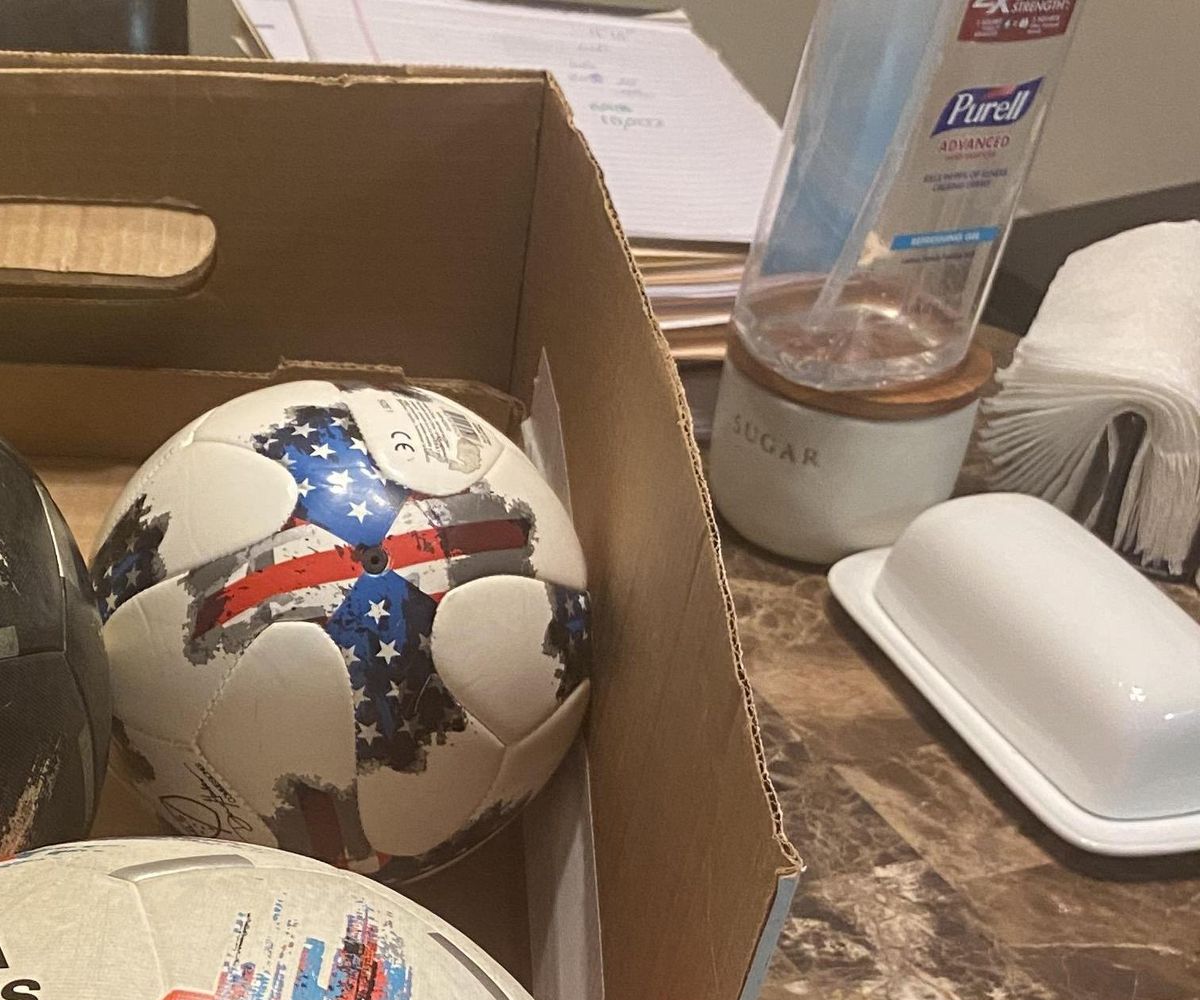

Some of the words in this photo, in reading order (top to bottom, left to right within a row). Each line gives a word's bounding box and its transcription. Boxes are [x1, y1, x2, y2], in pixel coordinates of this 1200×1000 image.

[947, 92, 1029, 125] Purell
[939, 135, 1010, 152] ADVANCED
[732, 413, 820, 467] SUGAR
